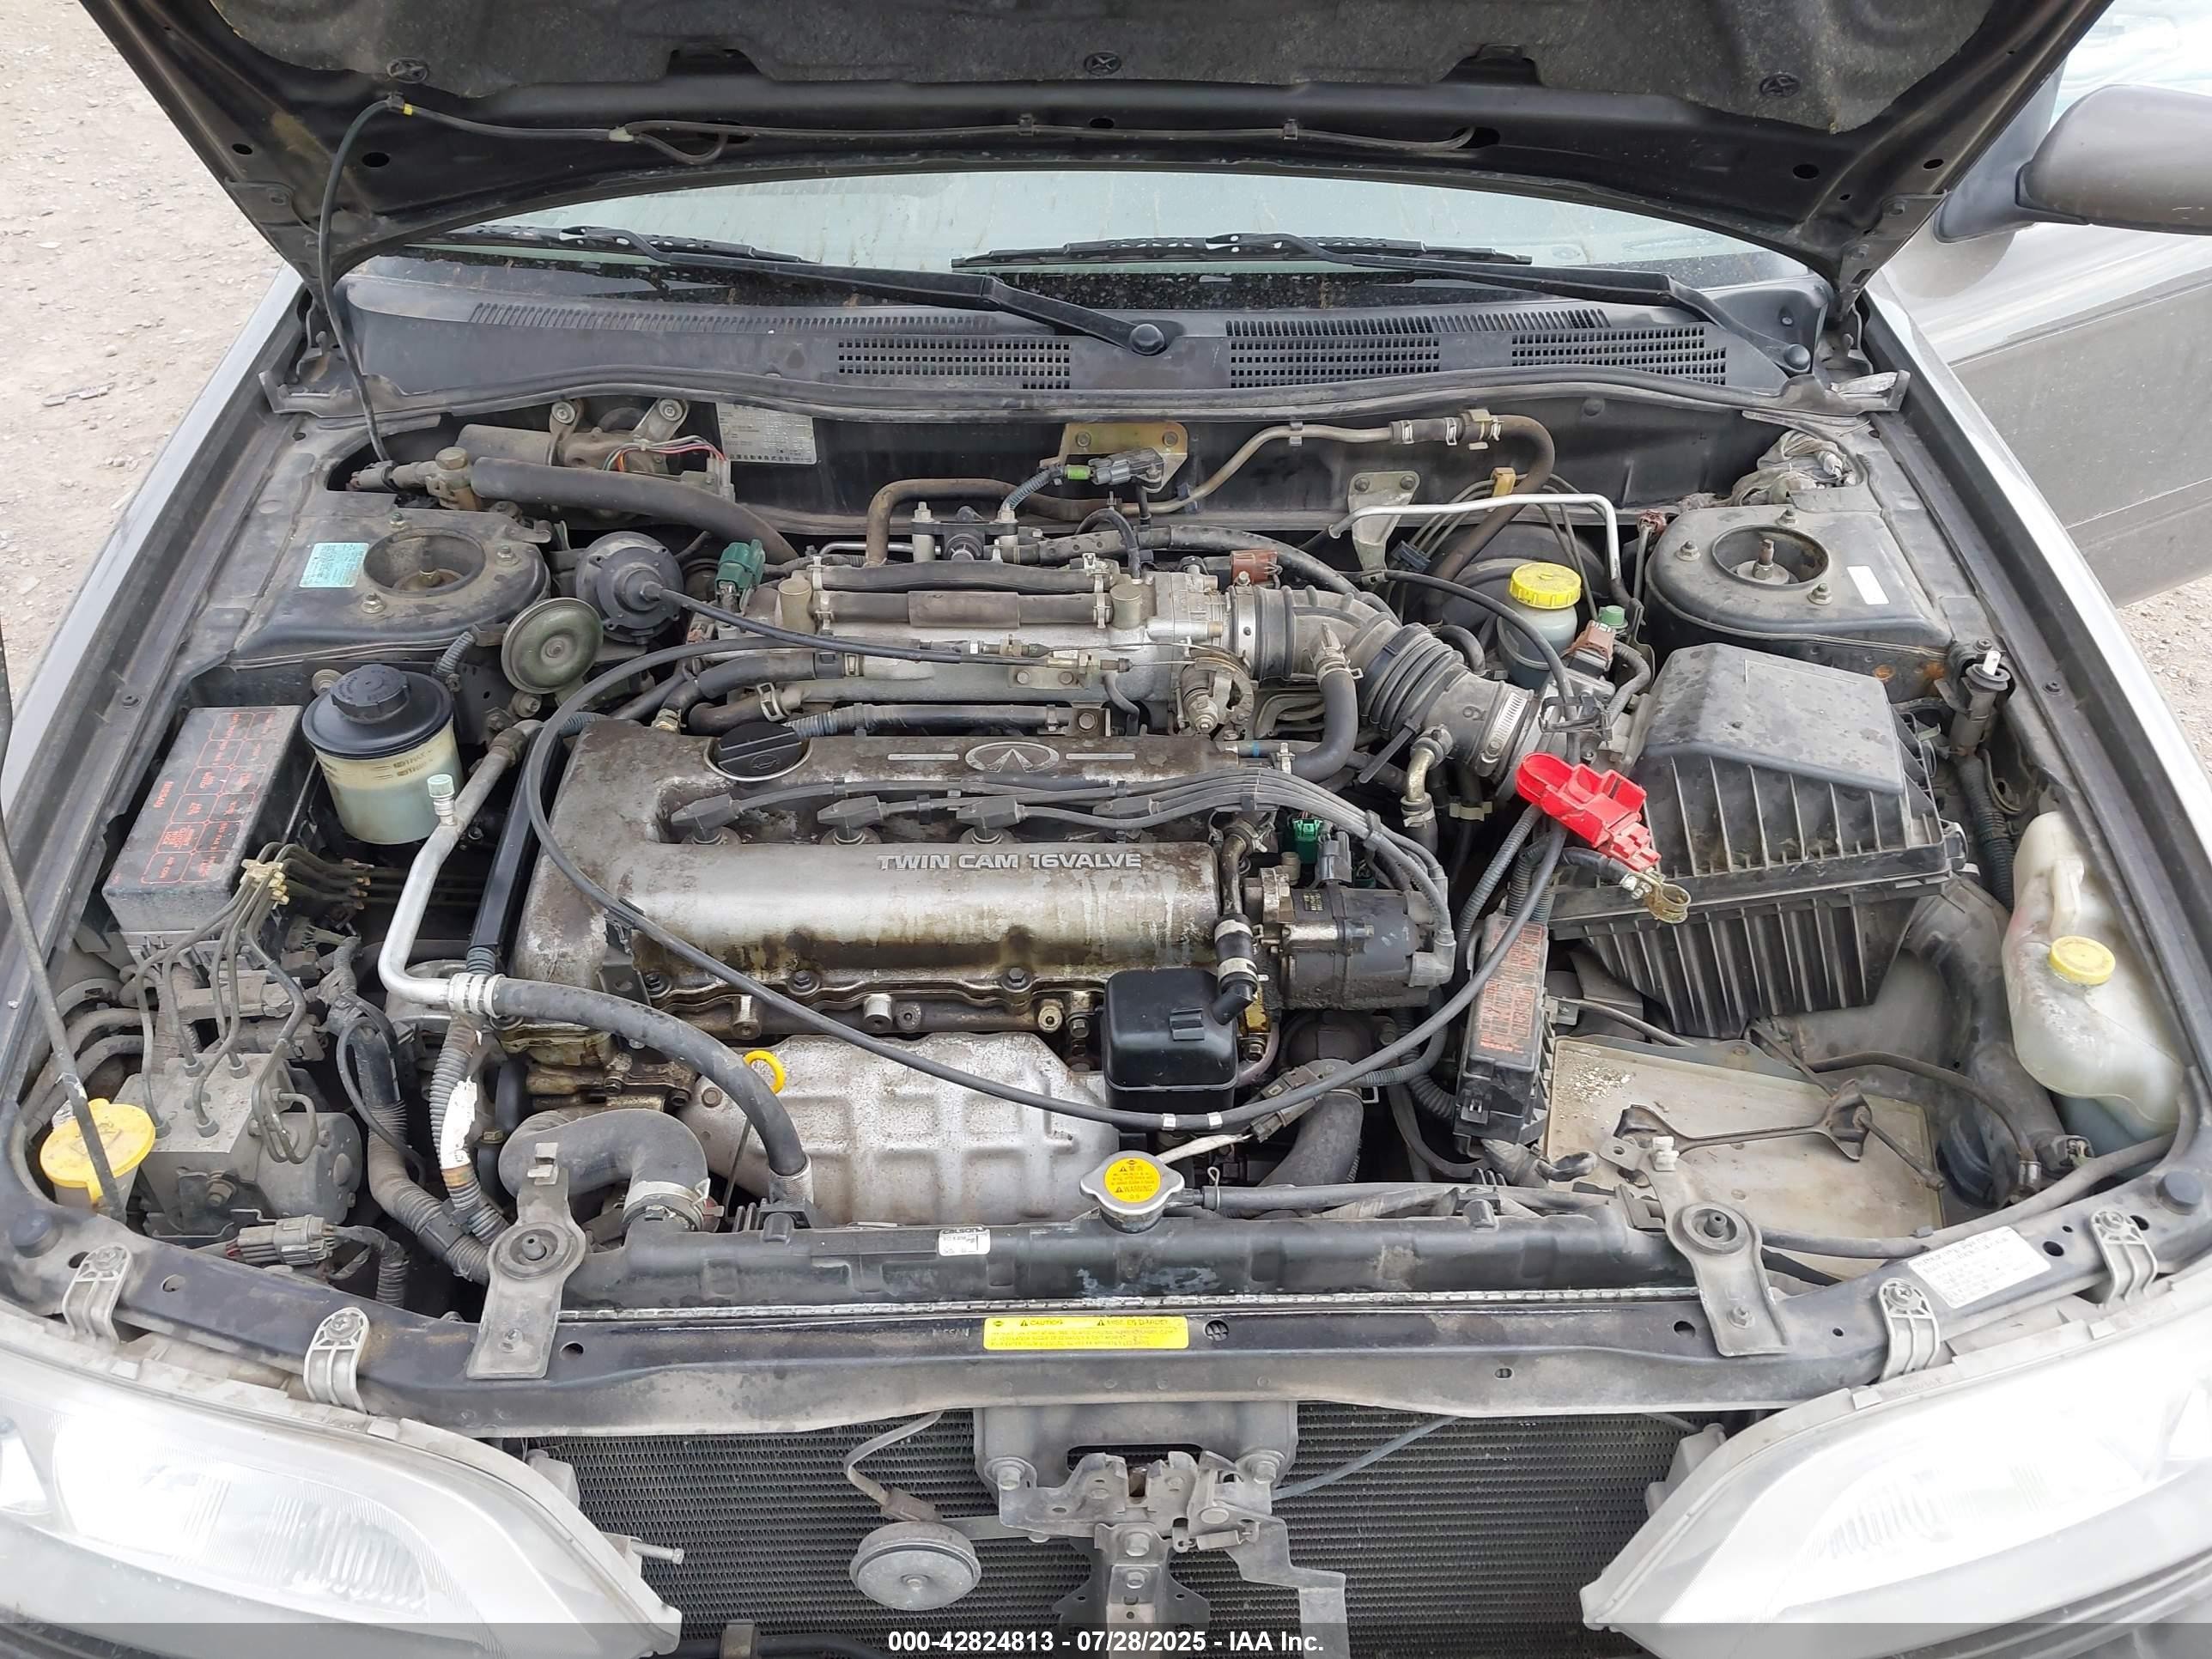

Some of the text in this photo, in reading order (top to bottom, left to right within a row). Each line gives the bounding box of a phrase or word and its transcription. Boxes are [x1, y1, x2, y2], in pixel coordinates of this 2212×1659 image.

[152, 781, 174, 808] NISSAN
[877, 853, 1142, 871] TWIN CAM 16VALVE
